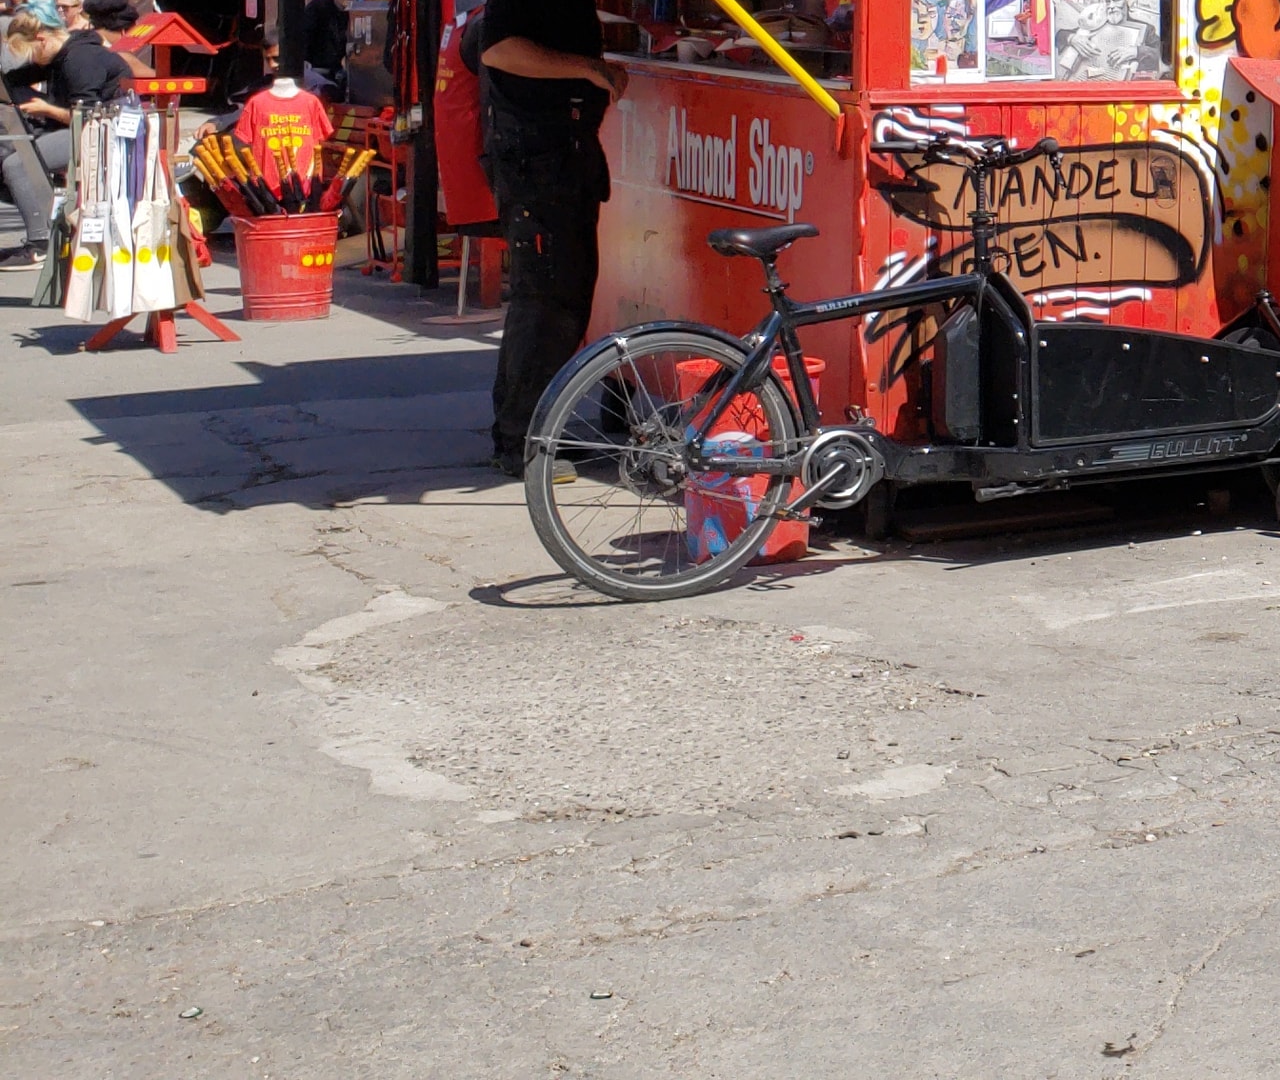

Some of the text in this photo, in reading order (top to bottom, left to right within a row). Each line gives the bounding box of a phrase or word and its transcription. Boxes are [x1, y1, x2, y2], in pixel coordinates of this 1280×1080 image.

[665, 105, 736, 201] Almond
[749, 117, 803, 224] Shop
[1149, 433, 1242, 460] BULLITT
